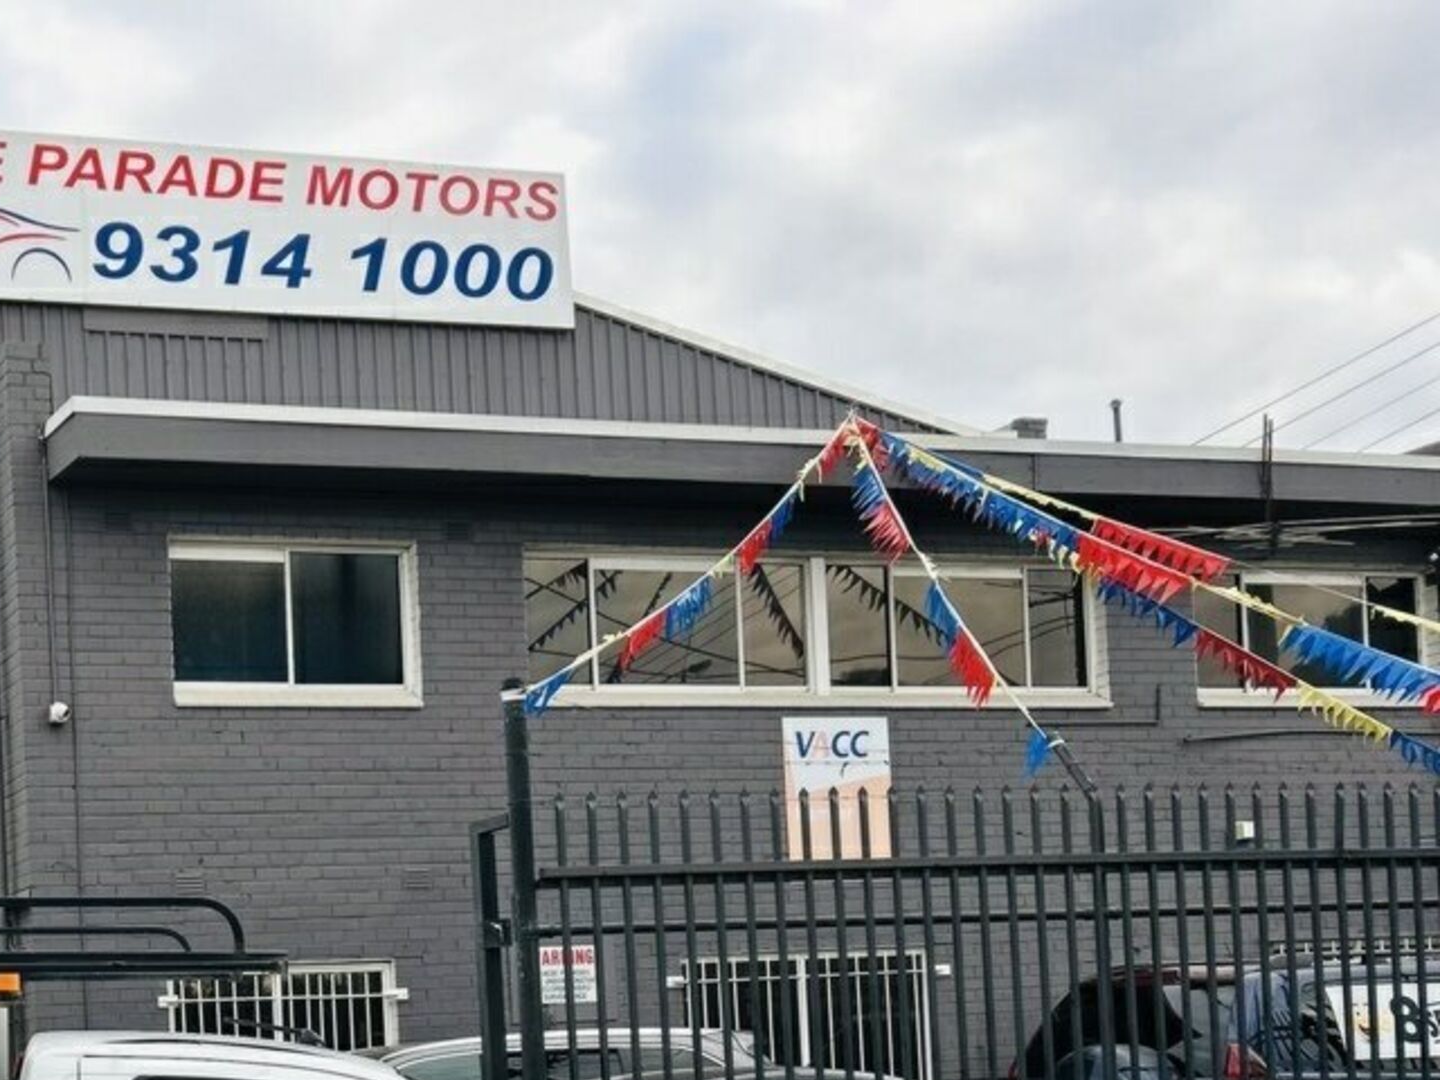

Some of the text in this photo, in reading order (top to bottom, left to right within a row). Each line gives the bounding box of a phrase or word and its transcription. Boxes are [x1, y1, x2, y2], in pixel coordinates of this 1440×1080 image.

[28, 144, 286, 203] PARADE
[306, 165, 558, 221] MOTORS
[93, 222, 553, 300] 9314 1000
[795, 730, 869, 758] VACC
